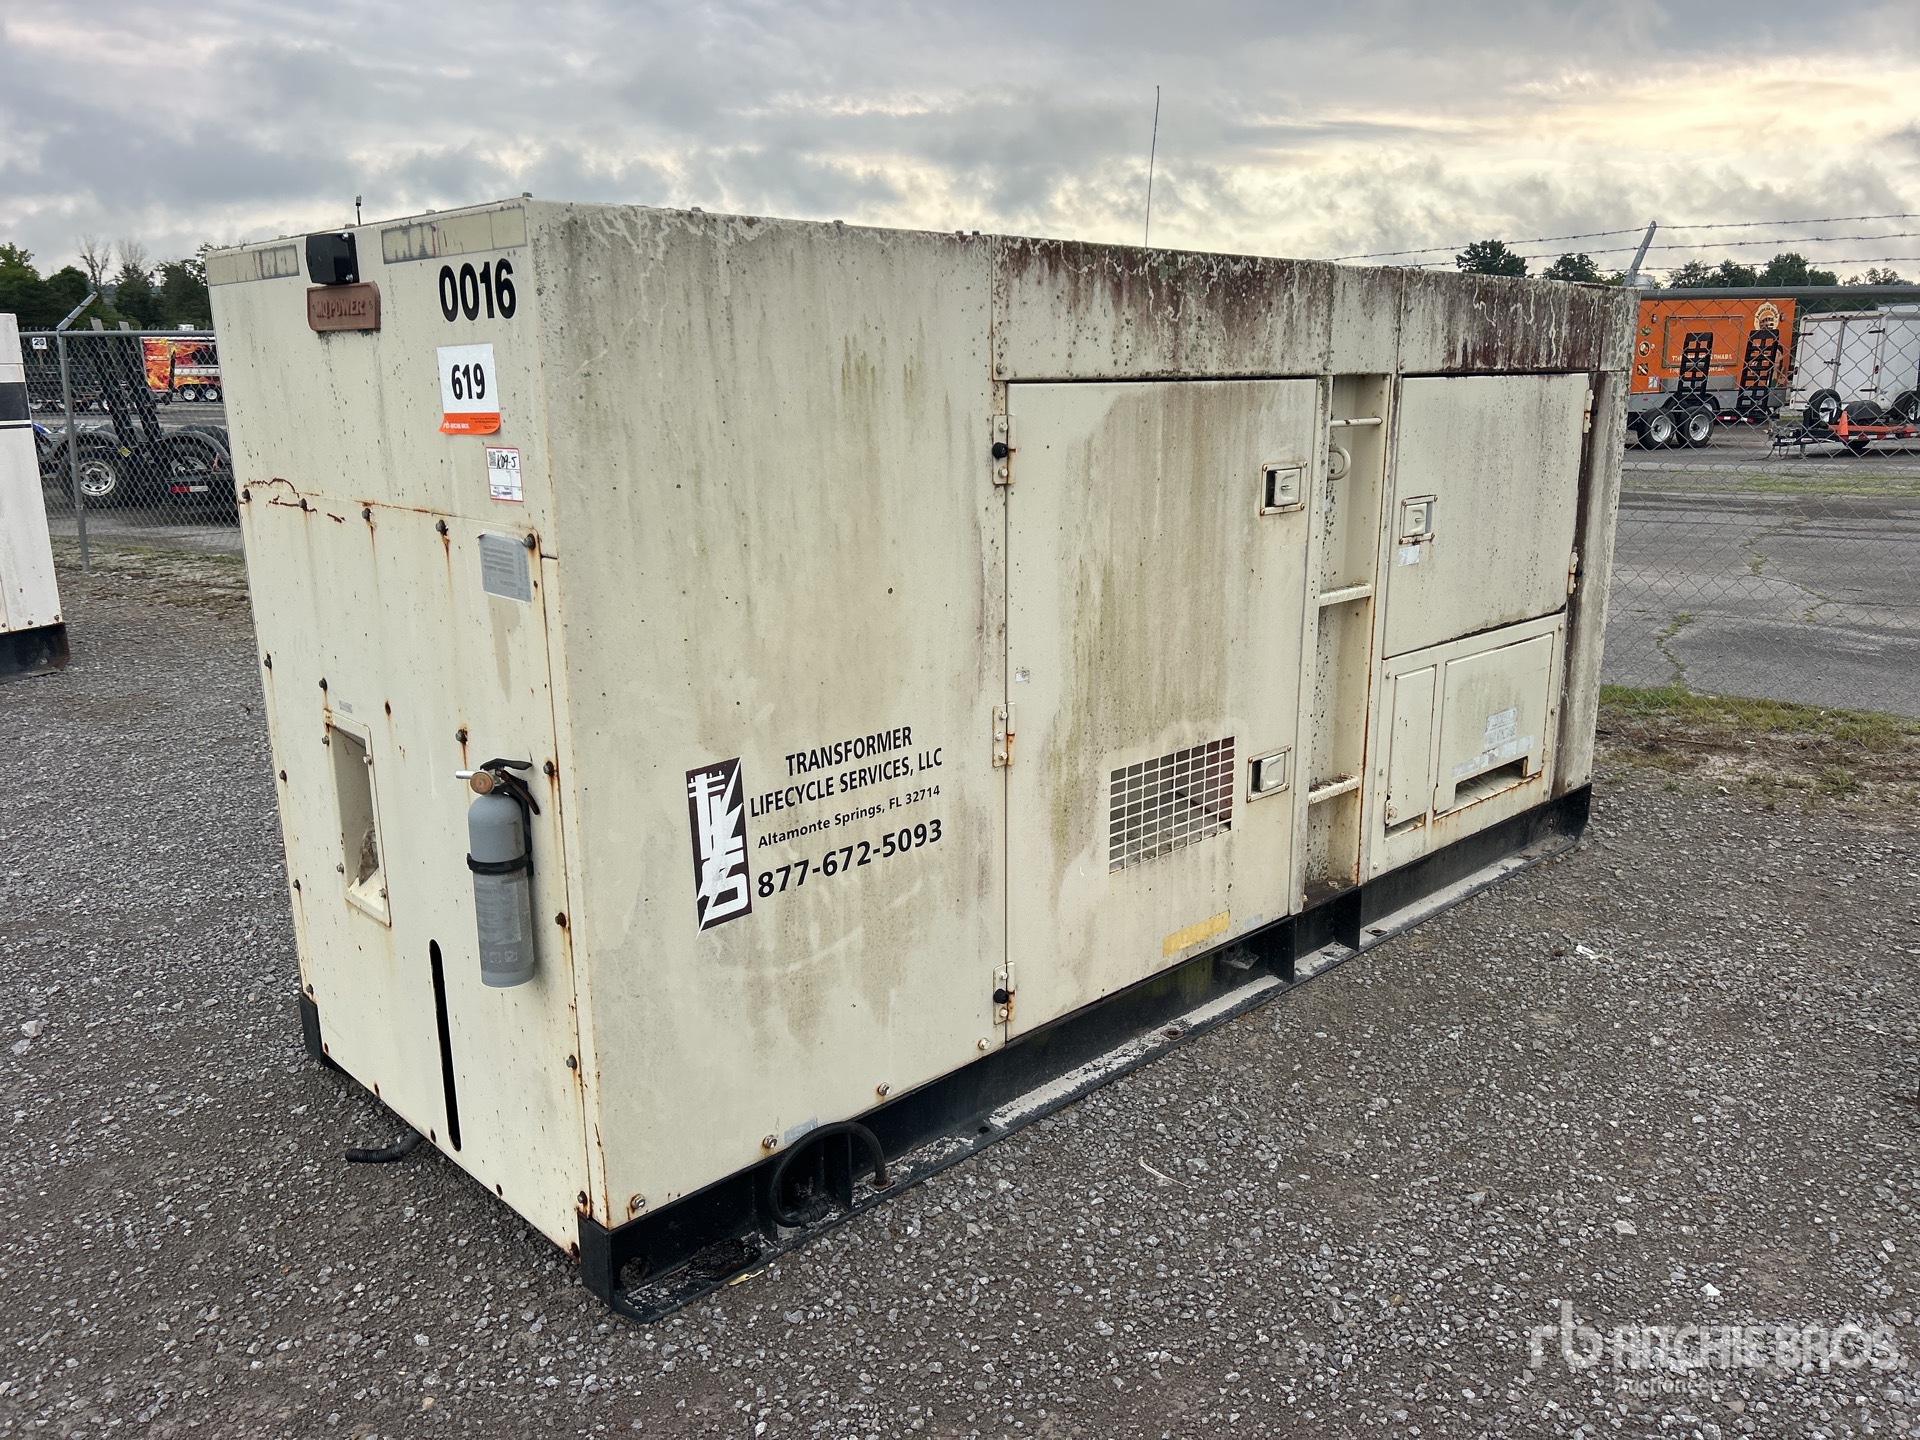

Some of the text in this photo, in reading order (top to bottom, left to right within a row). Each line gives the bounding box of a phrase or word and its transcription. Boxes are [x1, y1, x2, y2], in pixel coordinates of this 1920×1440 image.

[438, 258, 517, 323] 0016
[451, 362, 486, 401] 619
[750, 747, 943, 817] LIFECYCLE SERVICES, LLC
[785, 726, 913, 776] TRANSFORMER
[757, 784, 941, 849] Altamonte Springs, FL 32714
[757, 818, 943, 899] 877-672-5093
